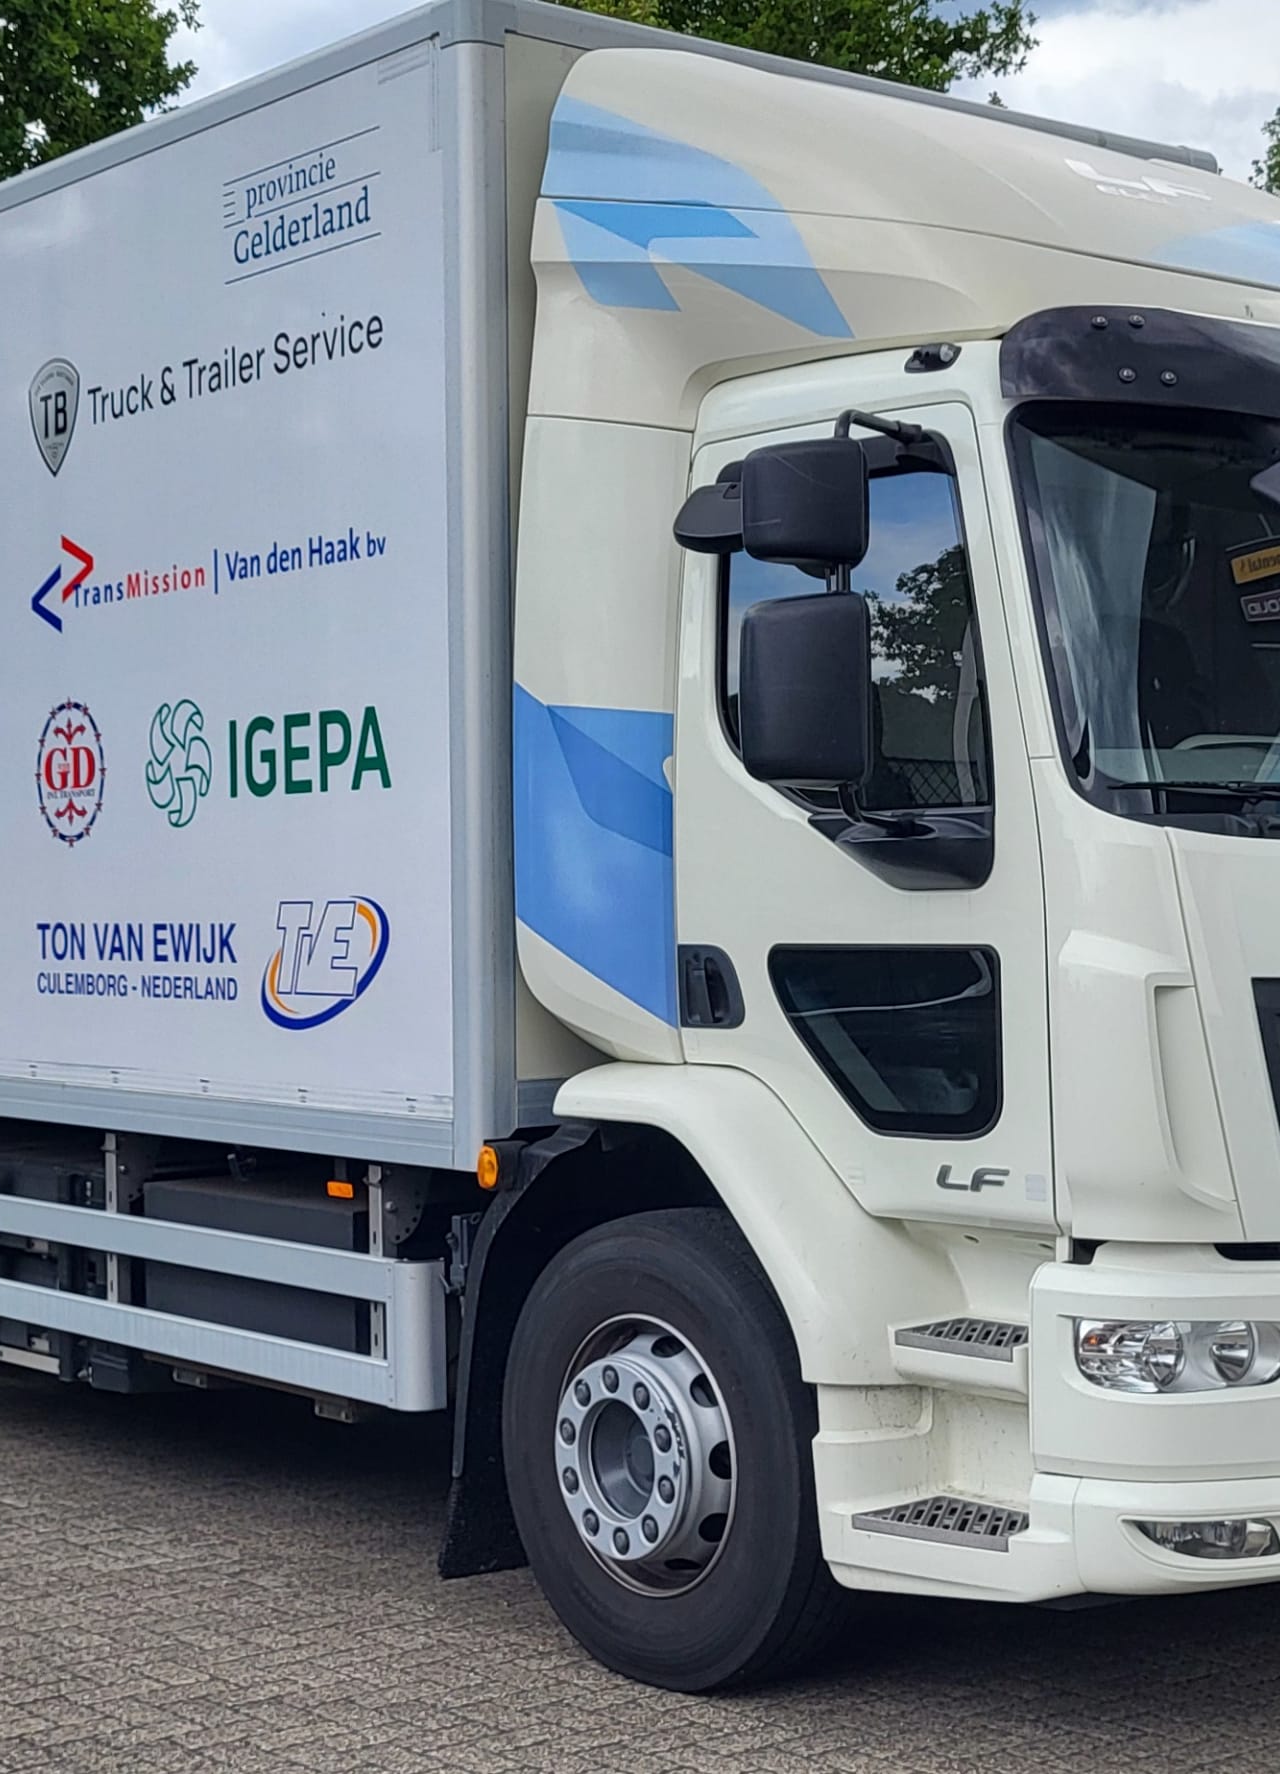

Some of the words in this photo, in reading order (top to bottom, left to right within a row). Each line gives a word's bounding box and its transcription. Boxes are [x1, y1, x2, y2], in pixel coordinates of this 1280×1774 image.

[245, 152, 336, 219] provincie
[233, 185, 372, 264] Gelderland
[87, 373, 154, 425] Truck
[160, 366, 177, 406] &
[182, 345, 265, 400] Trailer
[273, 313, 384, 375] Service
[39, 389, 68, 440] TB
[72, 564, 206, 609] TransMission
[225, 551, 261, 582] Van
[266, 541, 303, 575] den
[307, 527, 361, 568] Haak
[366, 531, 387, 558] bv
[44, 745, 96, 792] GD
[228, 705, 392, 798] IGEPA
[36, 922, 86, 961] TON
[93, 922, 144, 961] VAN
[153, 922, 238, 963] EWIJK
[37, 971, 128, 997] CULEMBORG
[141, 974, 238, 1001] NEDERLAND
[936, 1164, 1010, 1192] LF
